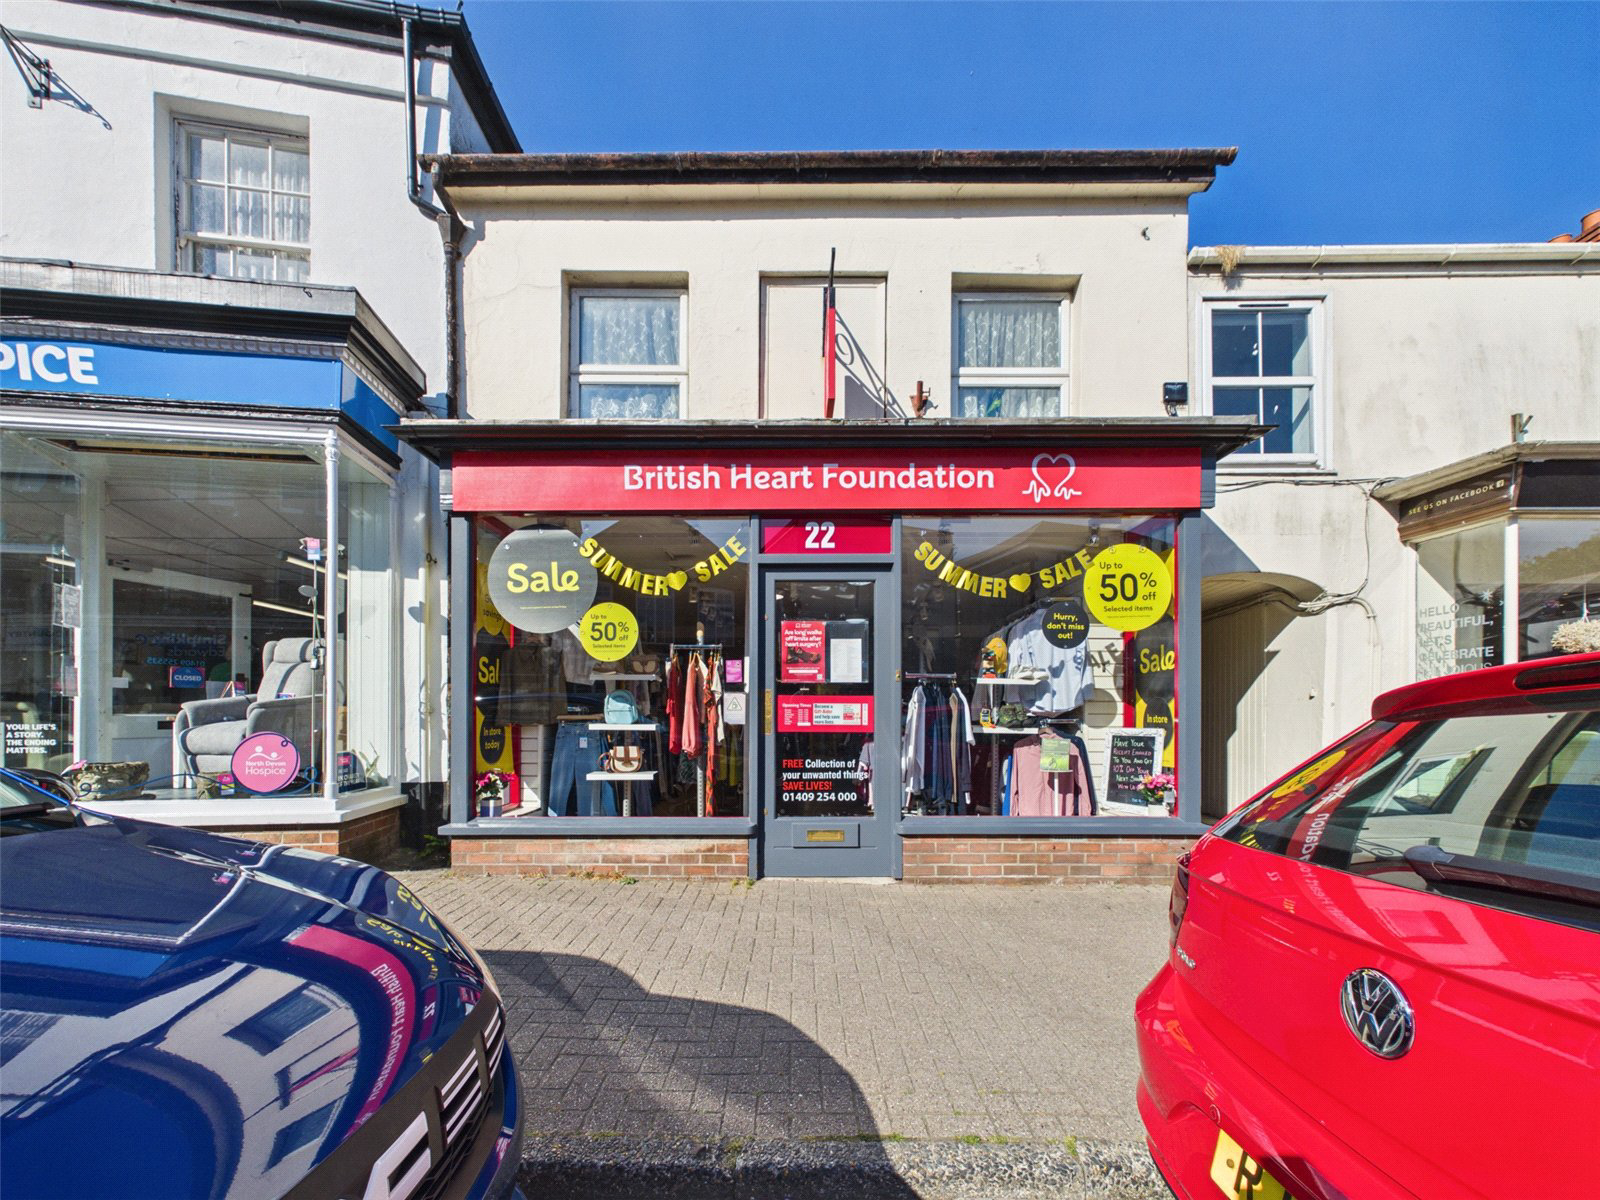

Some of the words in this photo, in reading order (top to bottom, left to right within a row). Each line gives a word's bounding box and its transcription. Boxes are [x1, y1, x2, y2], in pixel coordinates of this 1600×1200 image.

[623, 464, 720, 490] British
[730, 464, 814, 489] Heart
[822, 463, 994, 489] Foundation
[1408, 508, 1421, 516] SEE
[1423, 502, 1433, 510] US
[1436, 498, 1447, 507] ON
[1449, 483, 1494, 503] FACEBOOK
[805, 521, 835, 548] 22
[579, 537, 669, 596] SUMMER
[694, 535, 747, 582] SALE
[913, 541, 1007, 599] SUMMER
[1039, 548, 1095, 589] SALE
[1099, 561, 1112, 571] Up
[506, 561, 580, 594] Sale
[1099, 572, 1157, 602] 50%
[1142, 592, 1156, 600] off
[1053, 612, 1078, 622] Hurry,
[1419, 603, 1460, 618] HELLO
[590, 621, 630, 642] 50%
[1418, 614, 1494, 633] BEAUTIFUL,
[1139, 644, 1175, 674] Sale
[1418, 646, 1494, 662] CELEBRATE
[478, 656, 500, 684] Sal
[6, 723, 30, 731] YOUR
[31, 723, 57, 731] LIFE'S
[1146, 715, 1152, 723] In
[1153, 715, 1168, 723] store
[782, 759, 804, 768] FREE
[805, 758, 845, 768] Collection
[847, 758, 856, 768] of
[245, 767, 287, 776] Hospice
[782, 772, 801, 780] your
[802, 770, 841, 779] unwanted
[843, 770, 869, 781] things
[782, 781, 804, 790] SAVE
[805, 781, 832, 790] LIVES!
[782, 792, 815, 802] 01409
[816, 792, 836, 802] 254
[837, 792, 857, 802] 000
